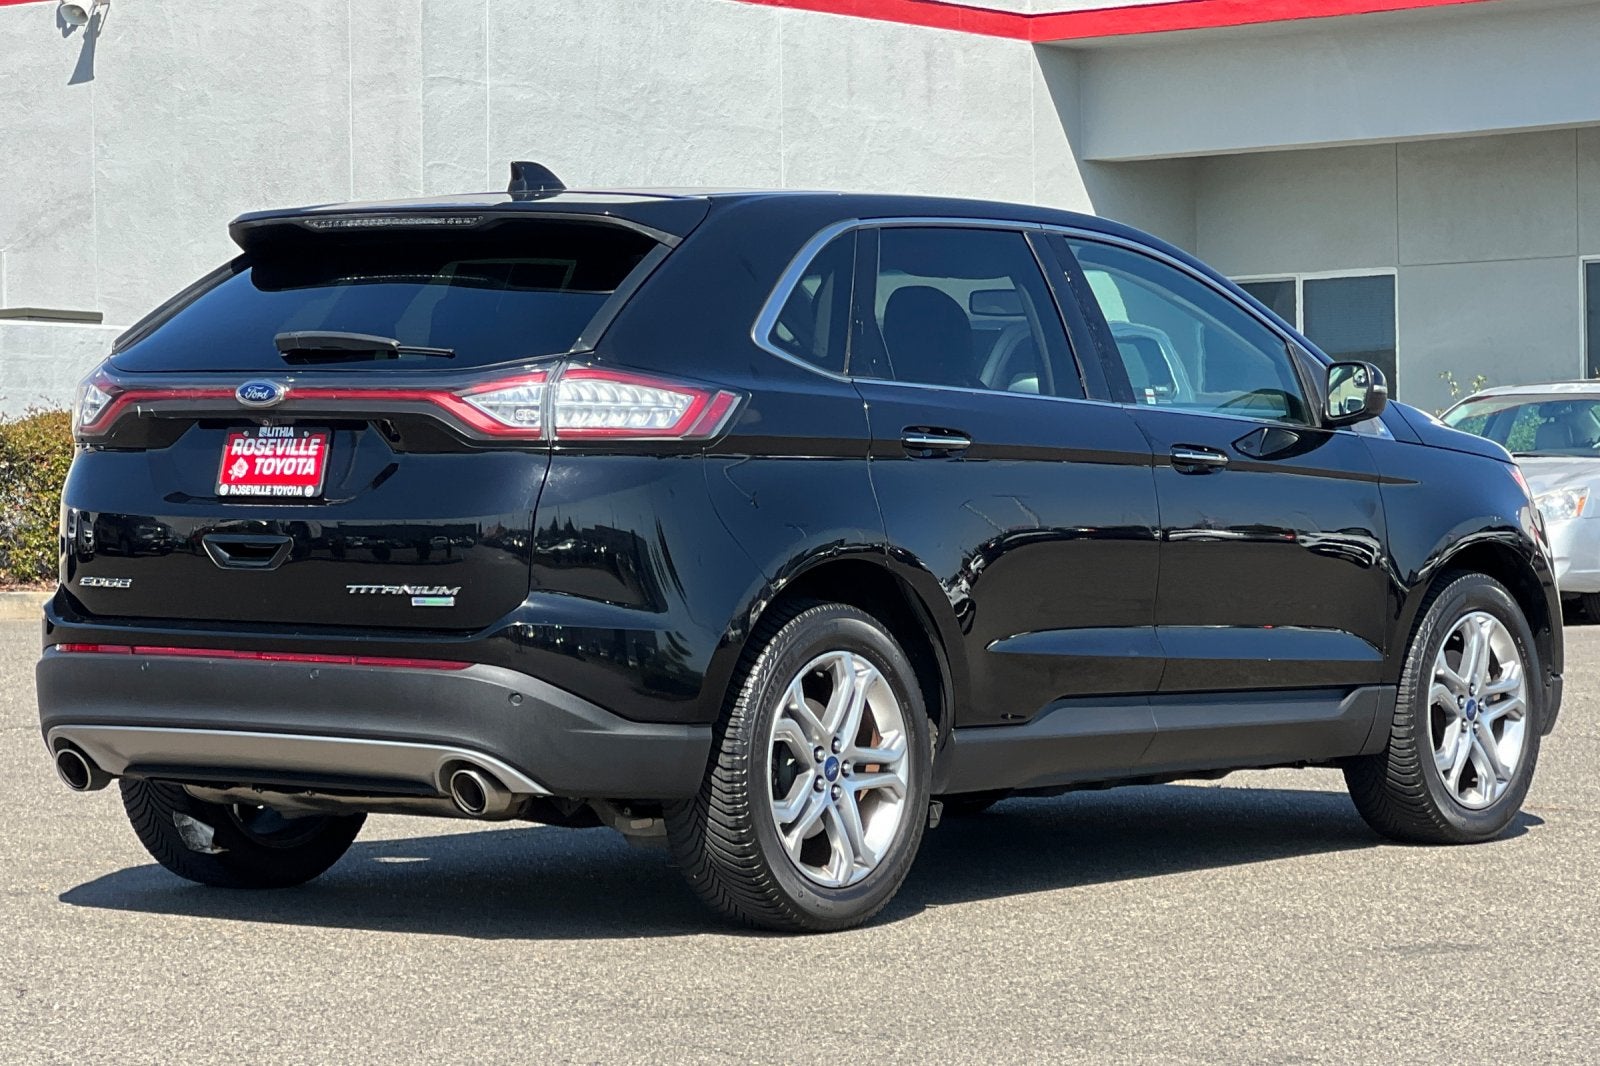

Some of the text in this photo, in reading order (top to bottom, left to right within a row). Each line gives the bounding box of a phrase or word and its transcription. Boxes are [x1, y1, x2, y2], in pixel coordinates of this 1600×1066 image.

[245, 385, 269, 399] Ford
[267, 427, 294, 437] LITHIA
[231, 439, 320, 456] ROSEVILLE
[254, 458, 316, 475] TOYOTA
[229, 485, 302, 496] ROSEVILLE TOYOTA
[79, 577, 132, 588] EDGE
[346, 585, 461, 596] TITANIUM
